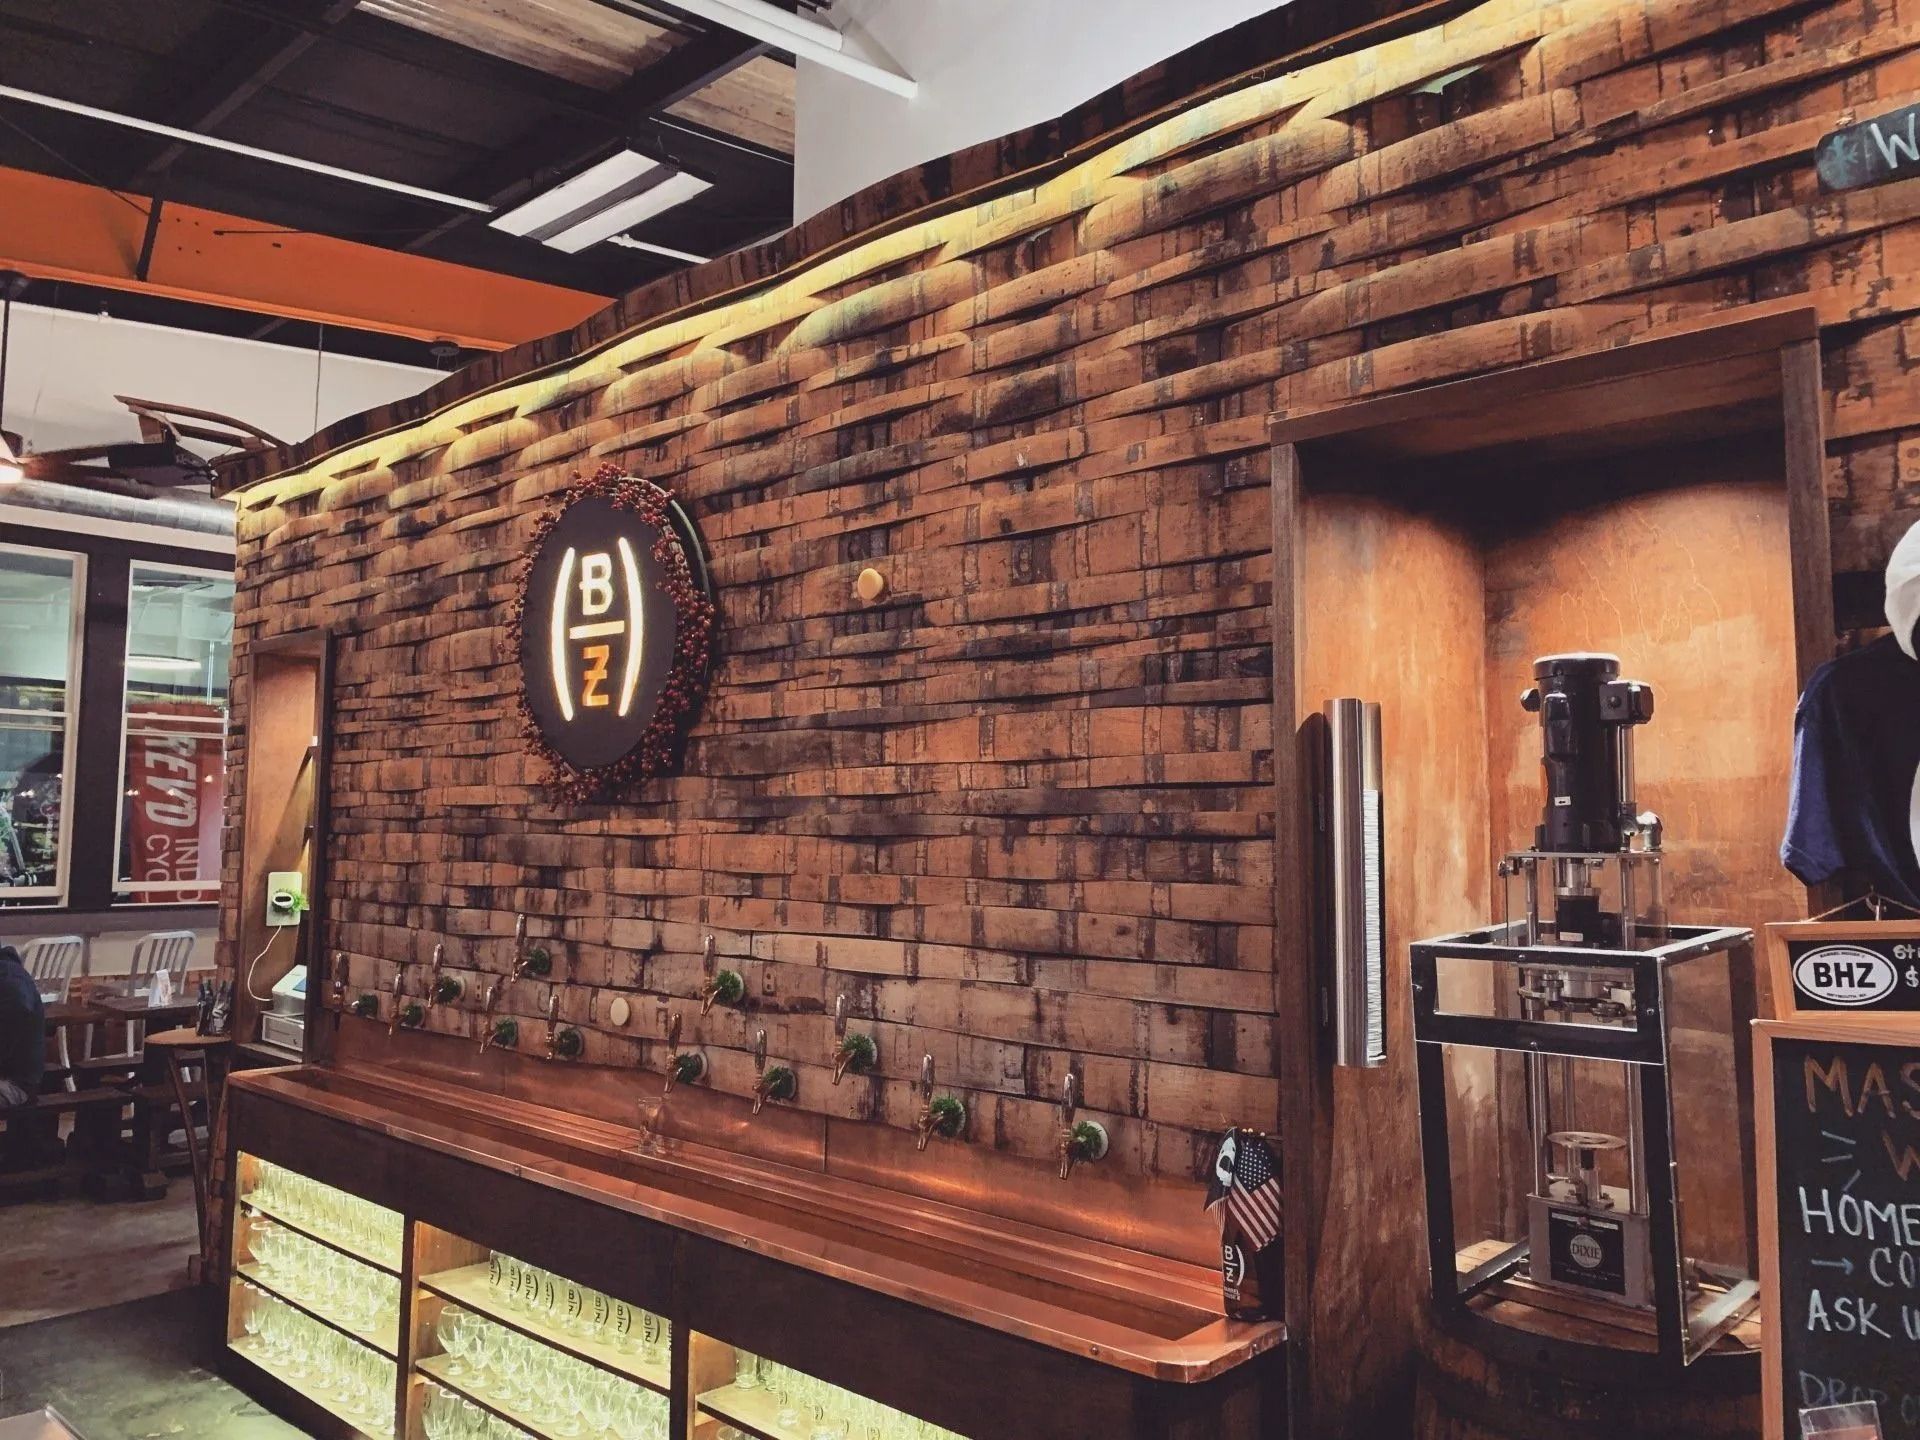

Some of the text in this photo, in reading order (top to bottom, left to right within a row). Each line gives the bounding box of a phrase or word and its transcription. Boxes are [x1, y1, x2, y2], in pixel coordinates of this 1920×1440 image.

[1812, 962, 1877, 988] BHZ
[1799, 1186, 1920, 1246] HOME
[1572, 1242, 1601, 1260] DIXIE
[1807, 1288, 1892, 1339] ASK
